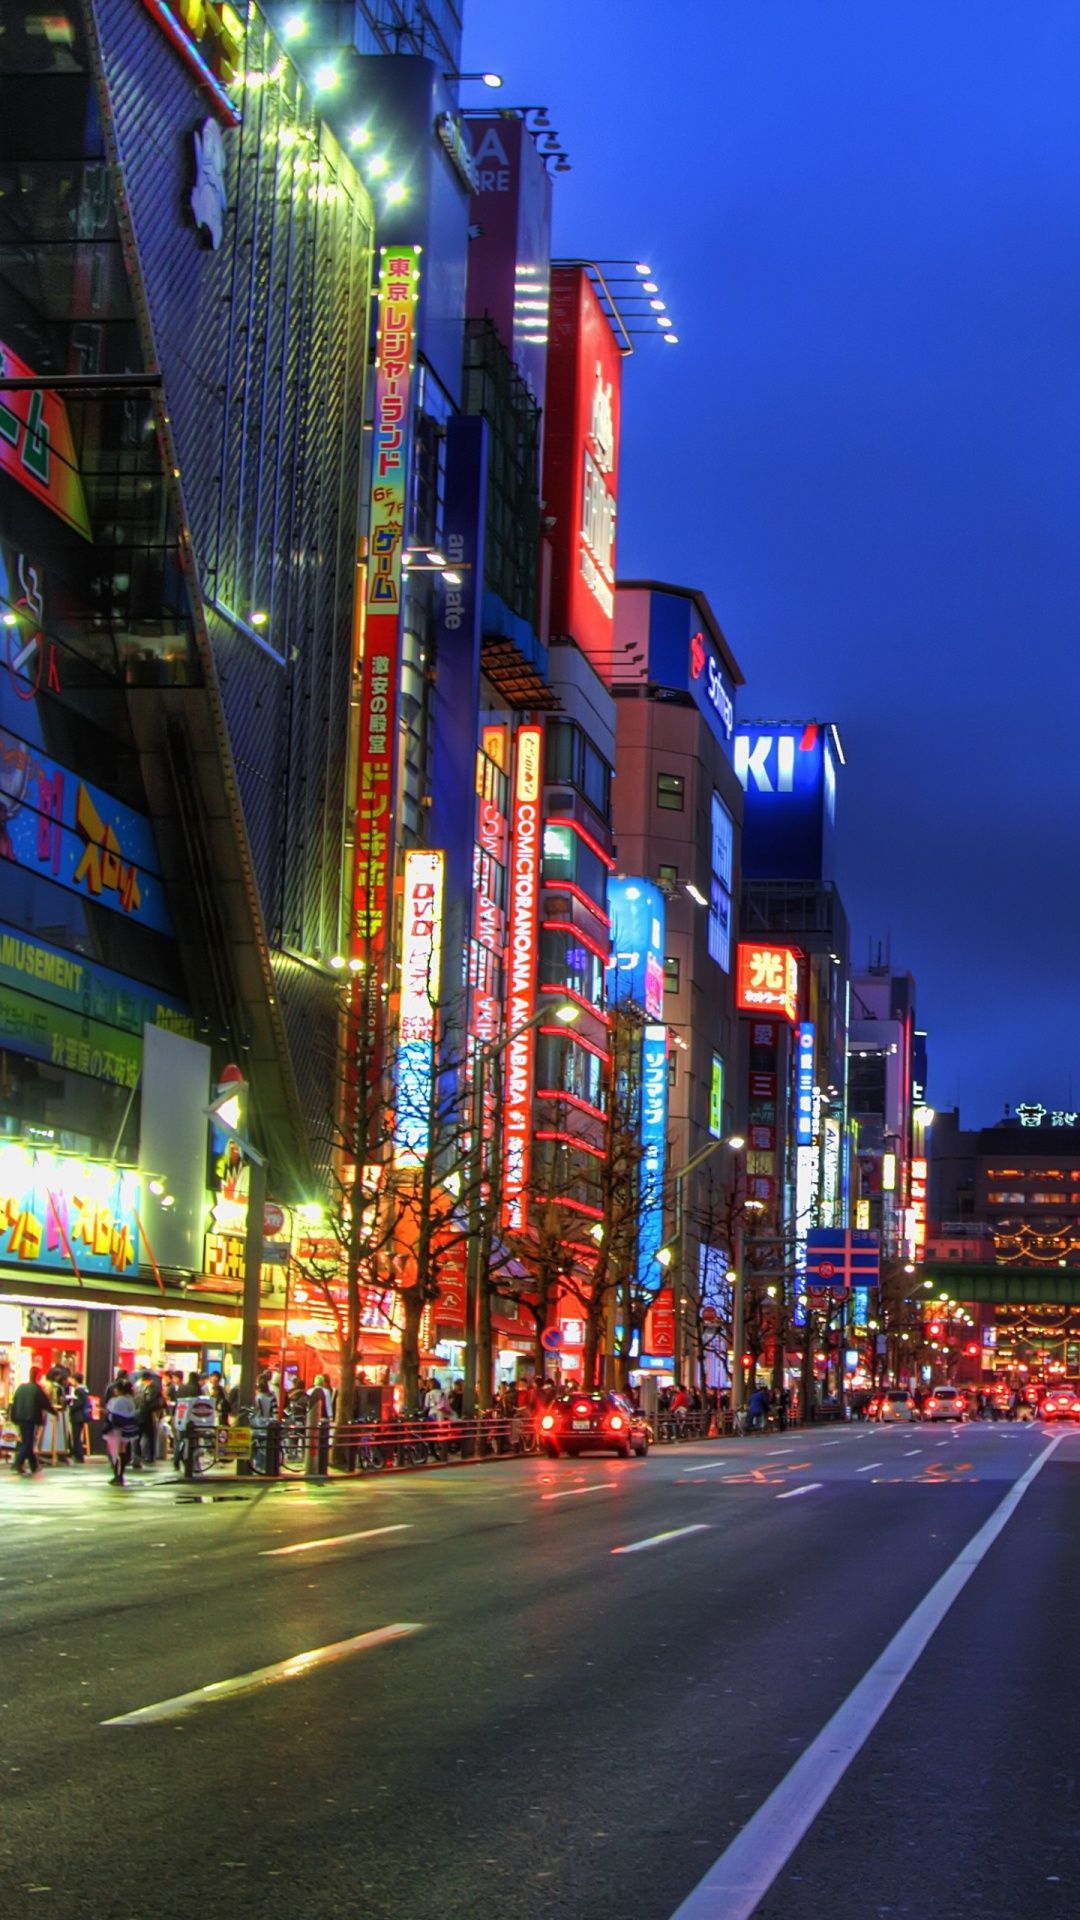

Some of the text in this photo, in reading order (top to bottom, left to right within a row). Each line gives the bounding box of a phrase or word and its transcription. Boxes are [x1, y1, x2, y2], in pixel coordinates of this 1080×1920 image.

[379, 257, 411, 477] 東京レジャーランド
[373, 486, 393, 502] 6F
[383, 501, 404, 518] 7F
[370, 520, 403, 604] ゲーム
[368, 655, 390, 754] 激安の殿堂
[411, 883, 434, 936] DVD
[511, 804, 536, 992] COMICTORANOANA
[0, 934, 83, 993] MUSEMENT
[749, 951, 784, 989] 光
[645, 1053, 665, 1124] ソフマップ
